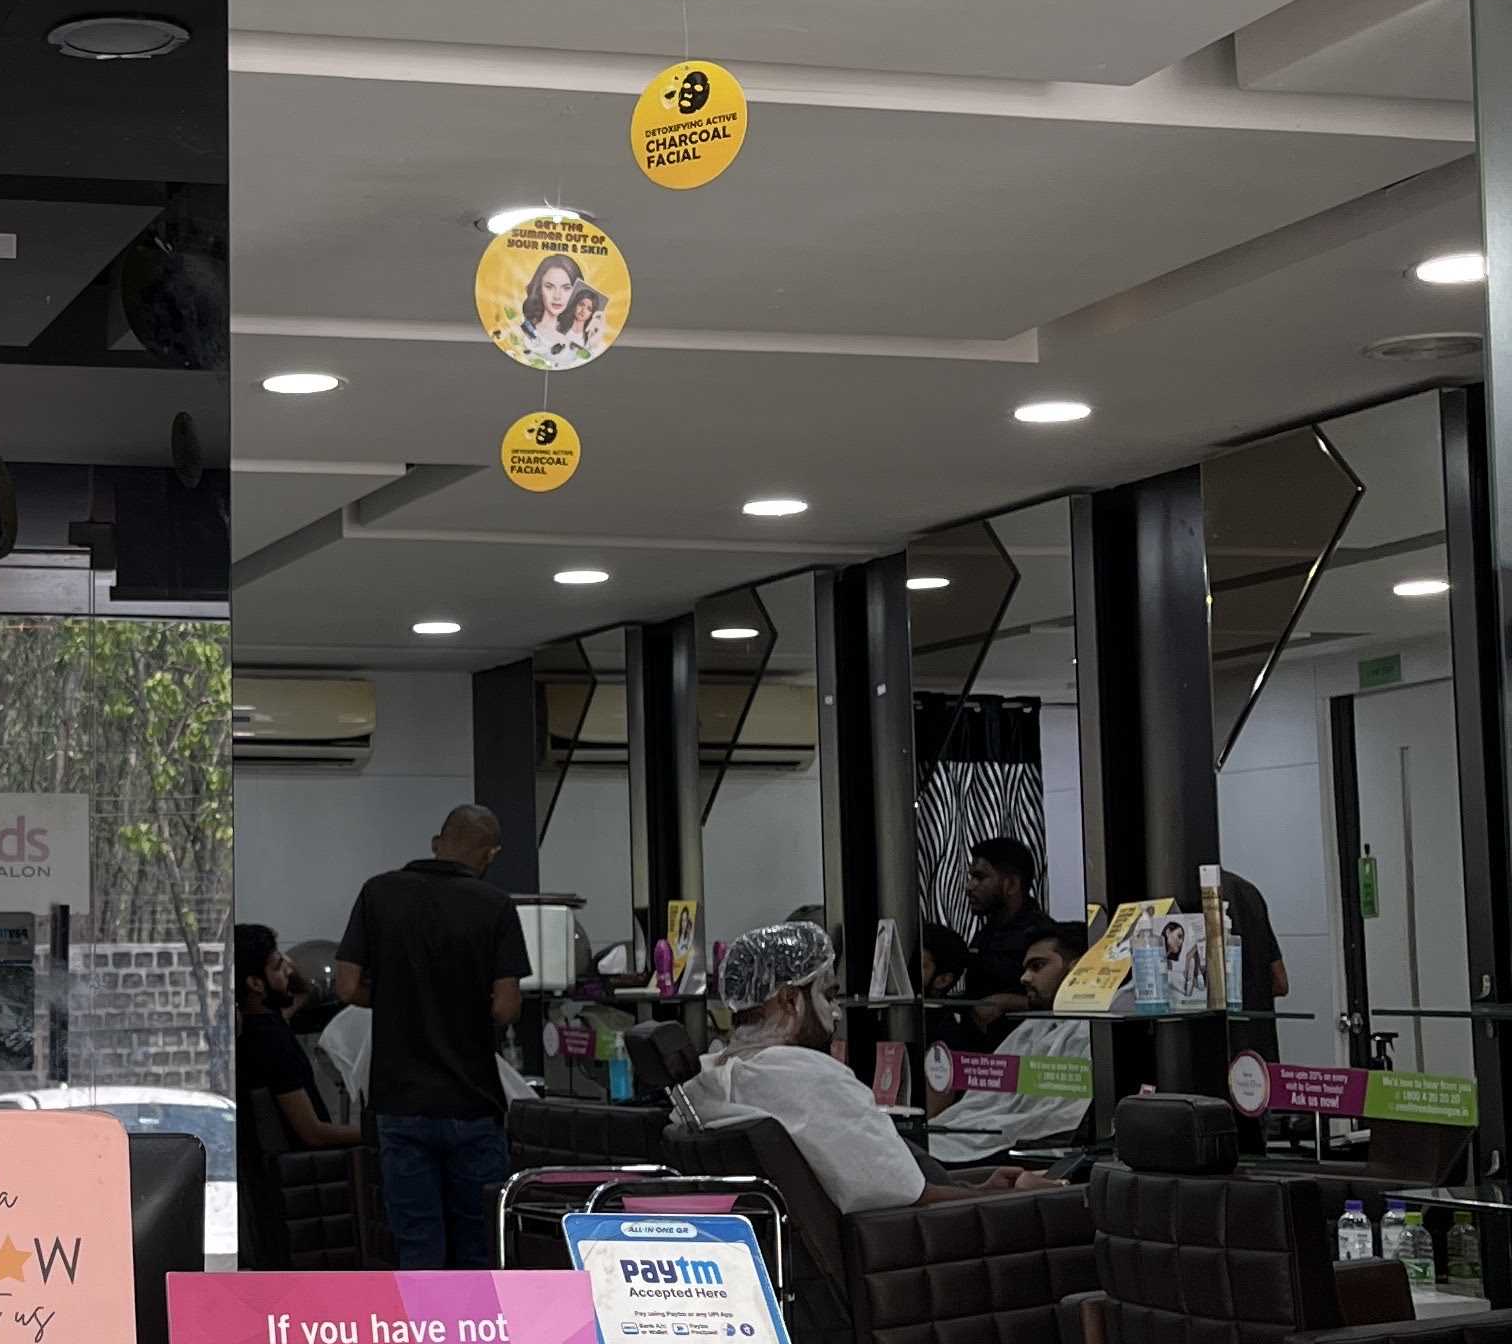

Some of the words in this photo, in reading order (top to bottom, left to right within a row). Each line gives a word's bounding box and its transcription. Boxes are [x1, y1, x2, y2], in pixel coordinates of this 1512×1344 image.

[645, 119, 704, 138] DETOXIFYING
[706, 112, 738, 126] ACTIVE
[645, 126, 731, 153] CHARCOAL
[647, 147, 701, 169] FACIAL
[507, 238, 539, 250] YOUR
[565, 233, 587, 244] OUT
[510, 455, 569, 466] CHARCOAL
[510, 465, 548, 475] FACIAL
[629, 1287, 693, 1300] Accepted
[696, 1287, 727, 1299] Here
[14, 1304, 56, 1343] us
[267, 1313, 290, 1344] If
[371, 1313, 446, 1344] have
[458, 1313, 510, 1344] not
